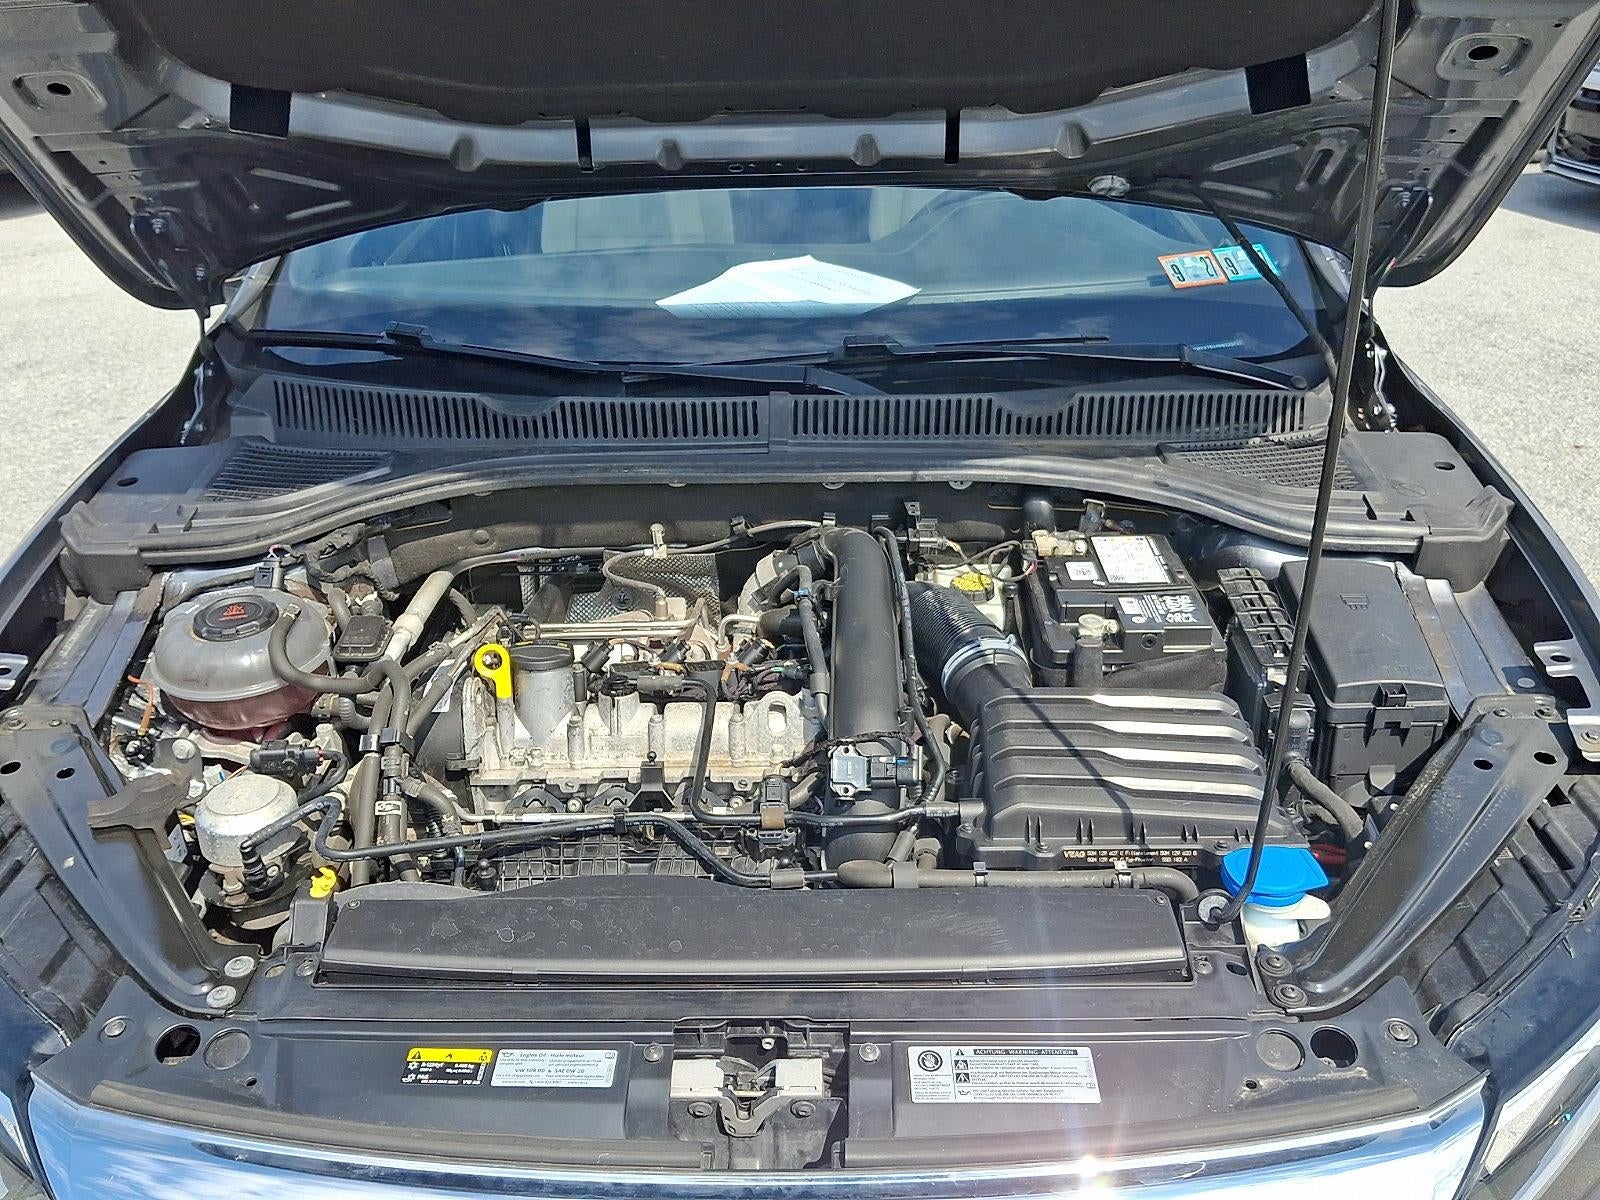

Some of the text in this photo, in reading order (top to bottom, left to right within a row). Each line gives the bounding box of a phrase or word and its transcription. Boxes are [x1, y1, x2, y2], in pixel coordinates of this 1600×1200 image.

[1170, 256, 1217, 282] 9 27
[1223, 257, 1238, 275] 9
